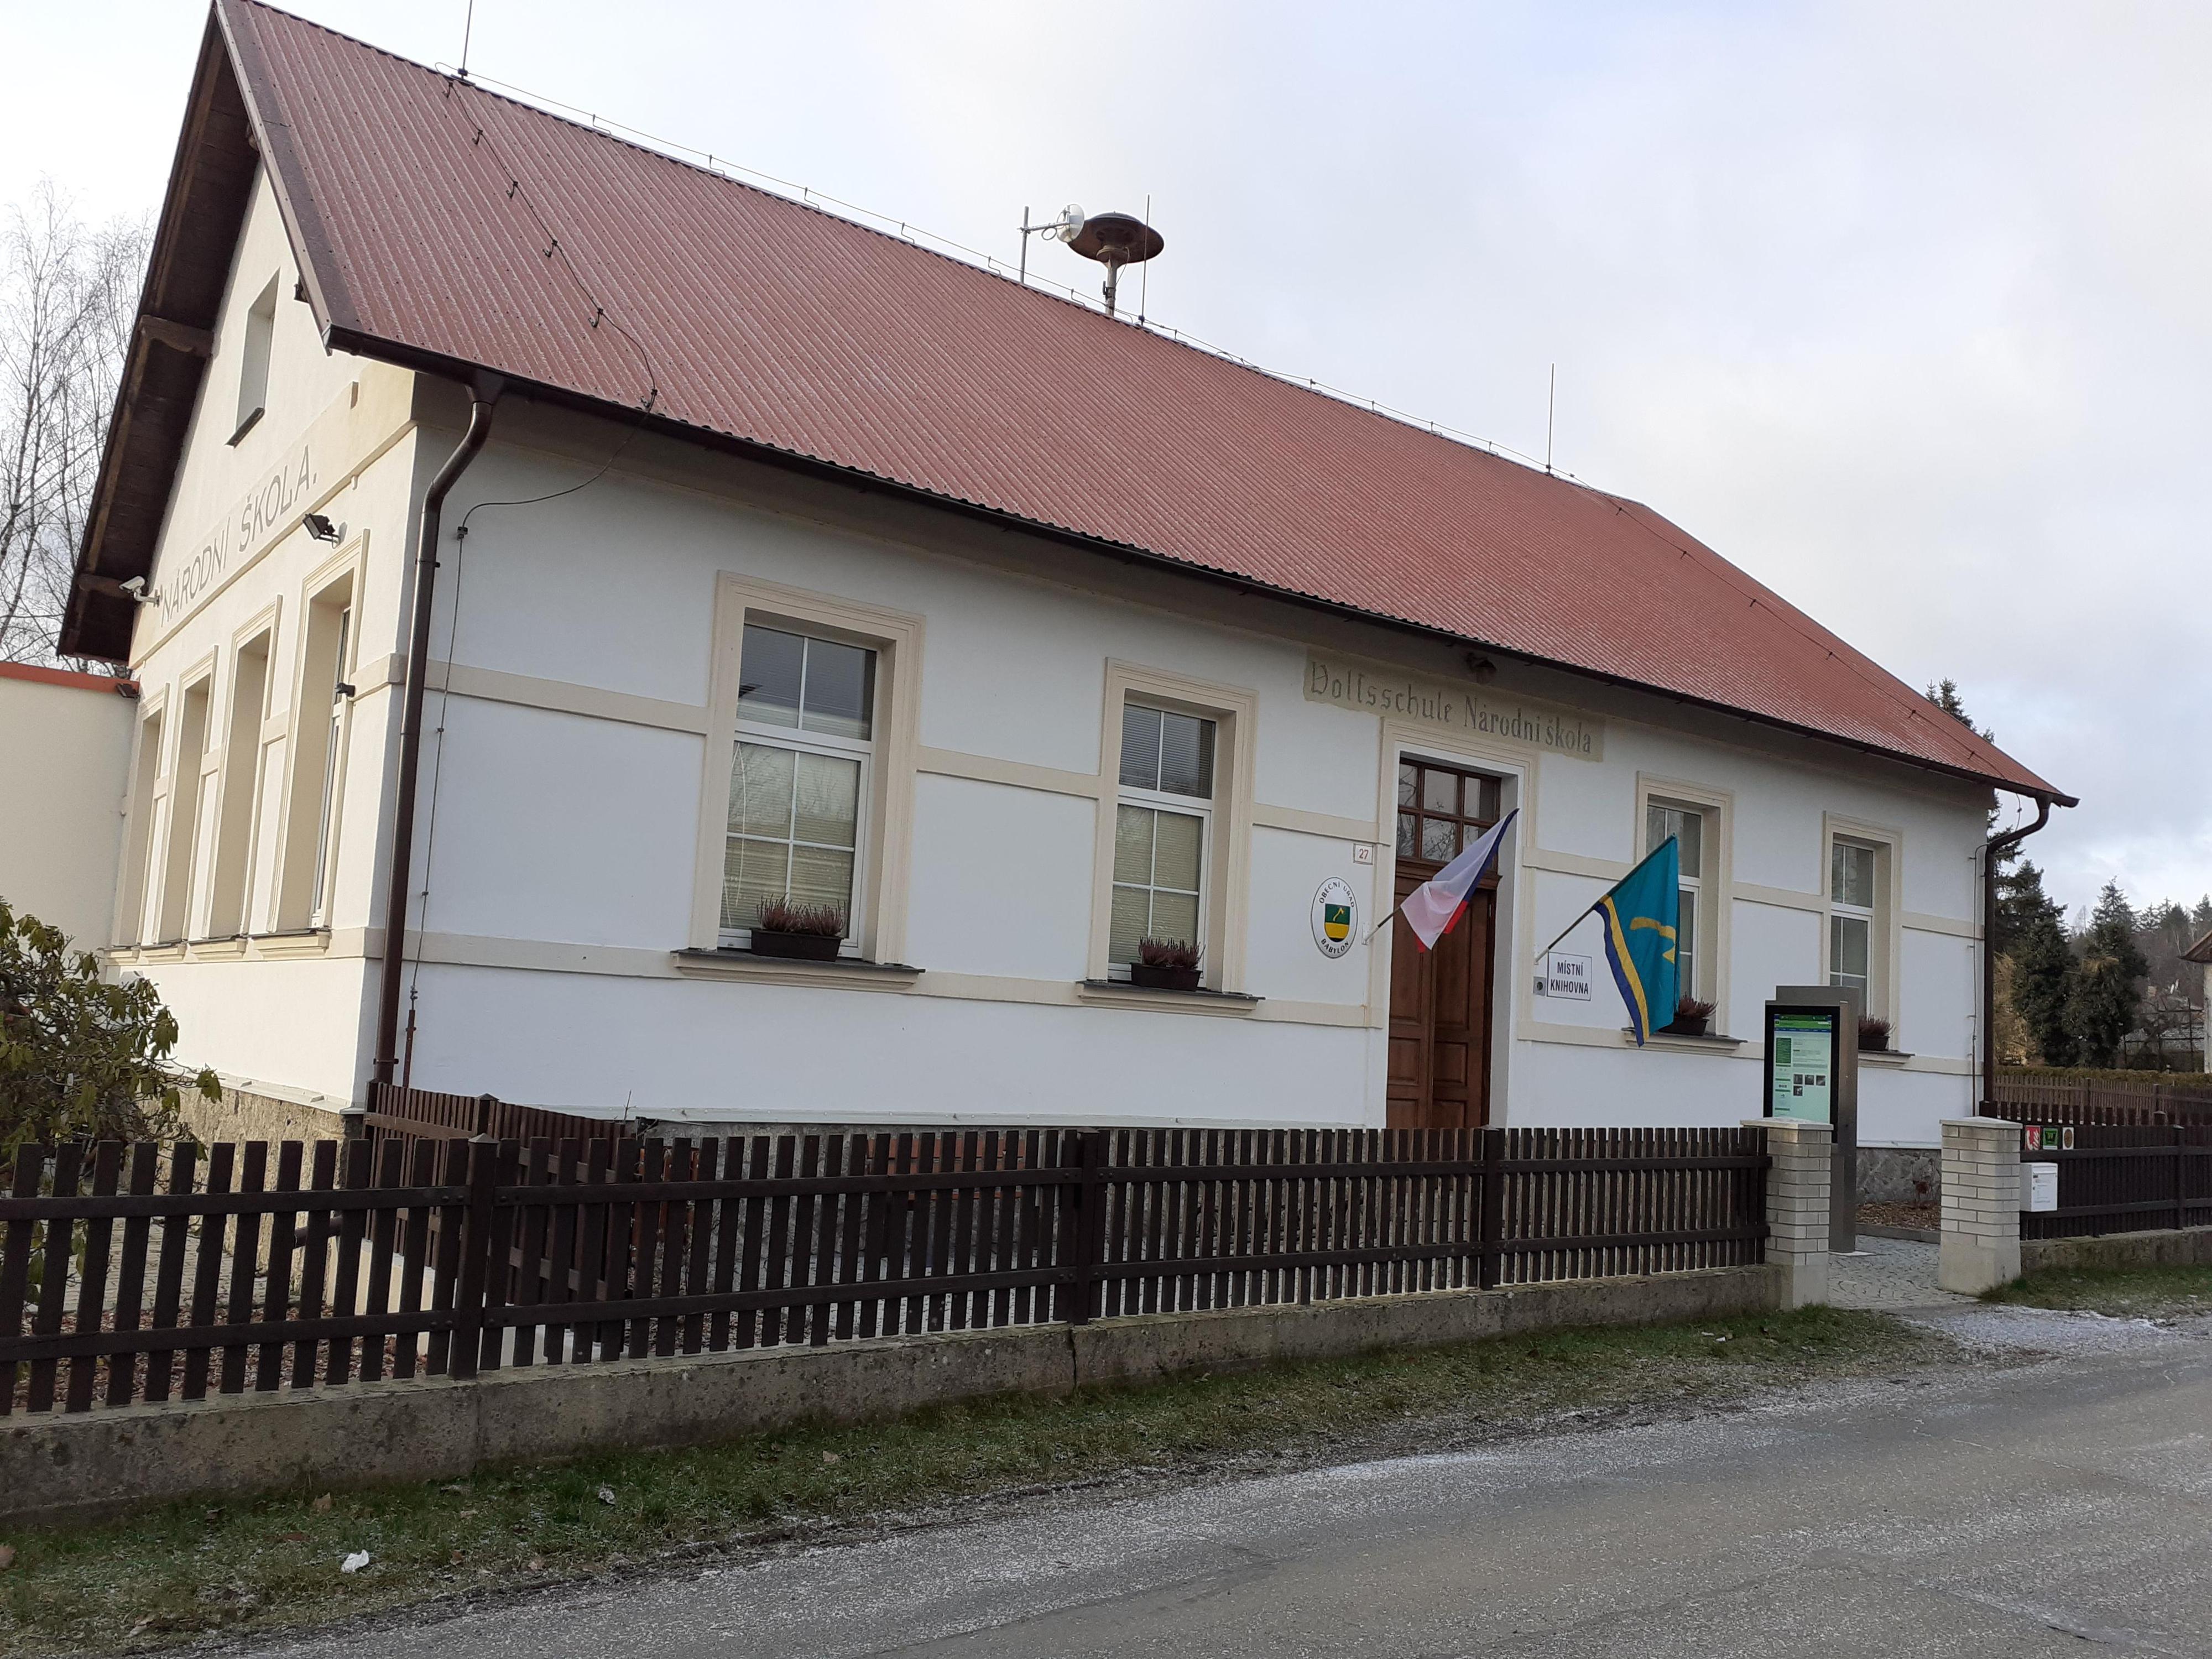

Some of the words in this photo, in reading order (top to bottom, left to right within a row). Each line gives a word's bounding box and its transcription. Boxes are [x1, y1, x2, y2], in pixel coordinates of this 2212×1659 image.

[1359, 848, 1369, 860] 27
[1321, 938, 1349, 954] BABYLON
[1557, 960, 1583, 977] MÍSTNÍ
[1550, 979, 1589, 994] KNIHOVNA
